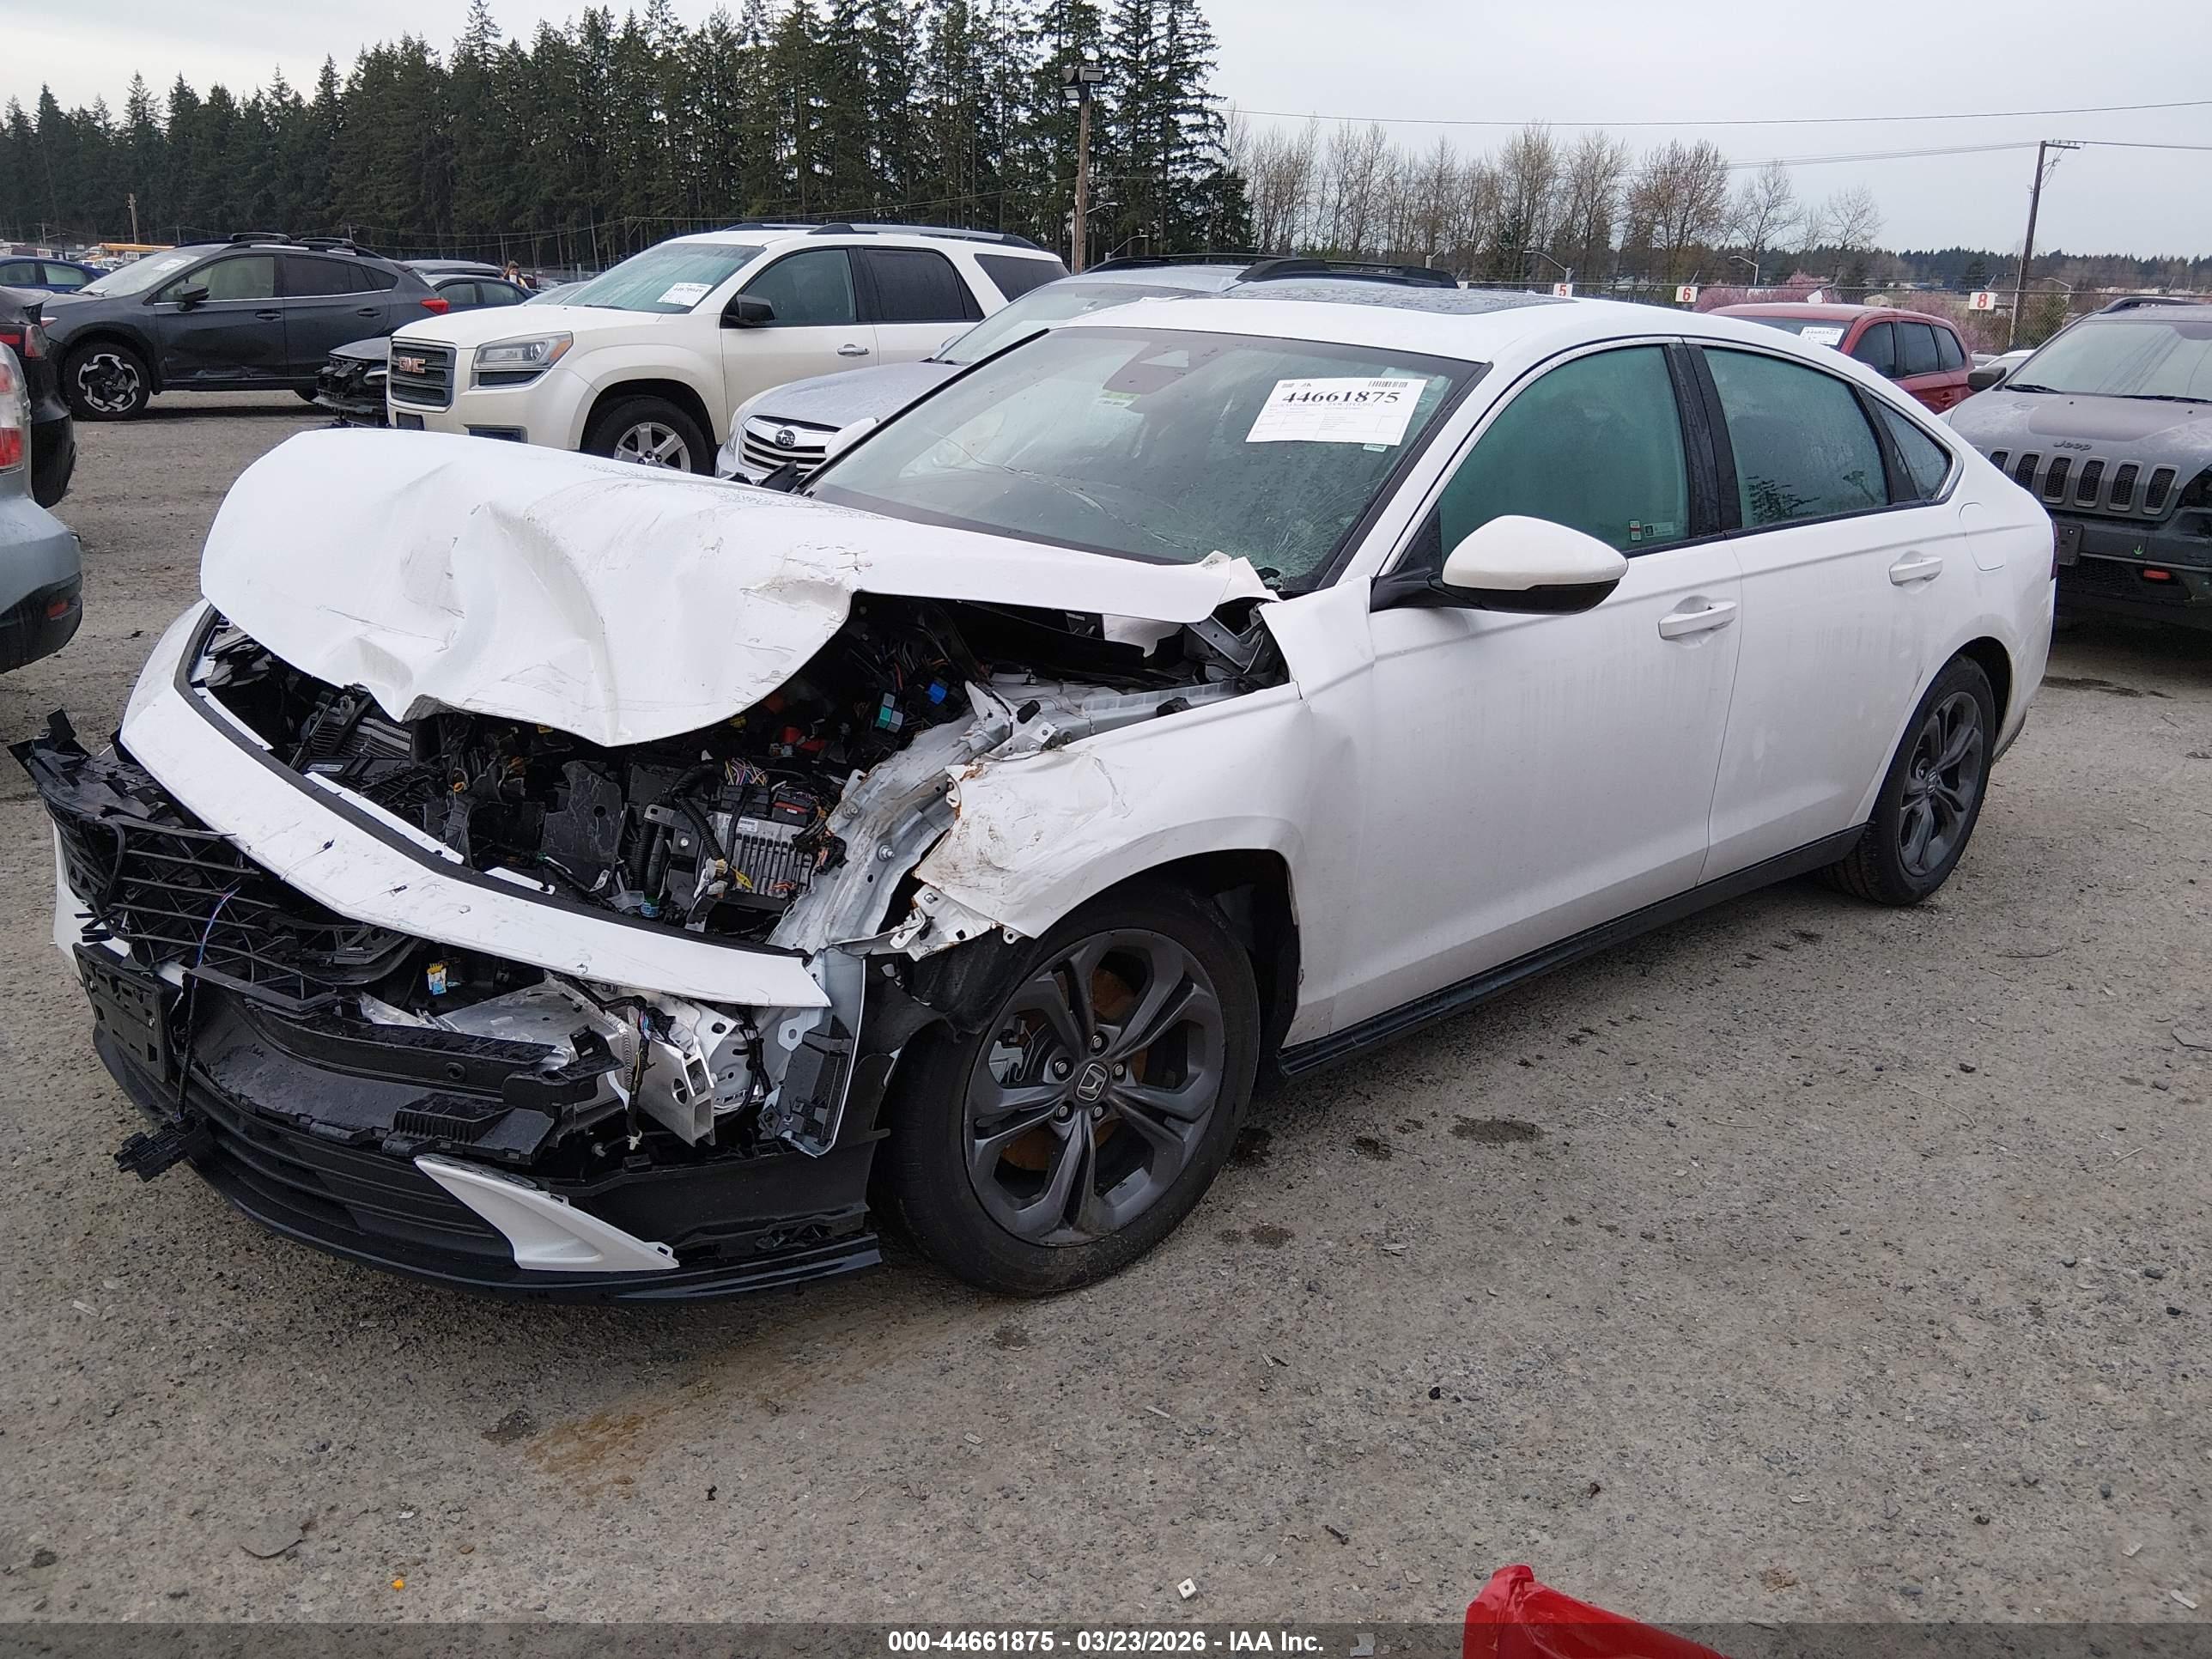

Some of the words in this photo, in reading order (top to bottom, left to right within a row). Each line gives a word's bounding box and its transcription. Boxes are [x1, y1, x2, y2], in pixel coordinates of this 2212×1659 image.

[1559, 284, 1566, 296] 5
[1683, 287, 1691, 301] 6
[1977, 293, 1988, 308] 8
[398, 356, 426, 374] GMC
[1282, 391, 1401, 404] 44661875
[2053, 440, 2093, 452] Jeep
